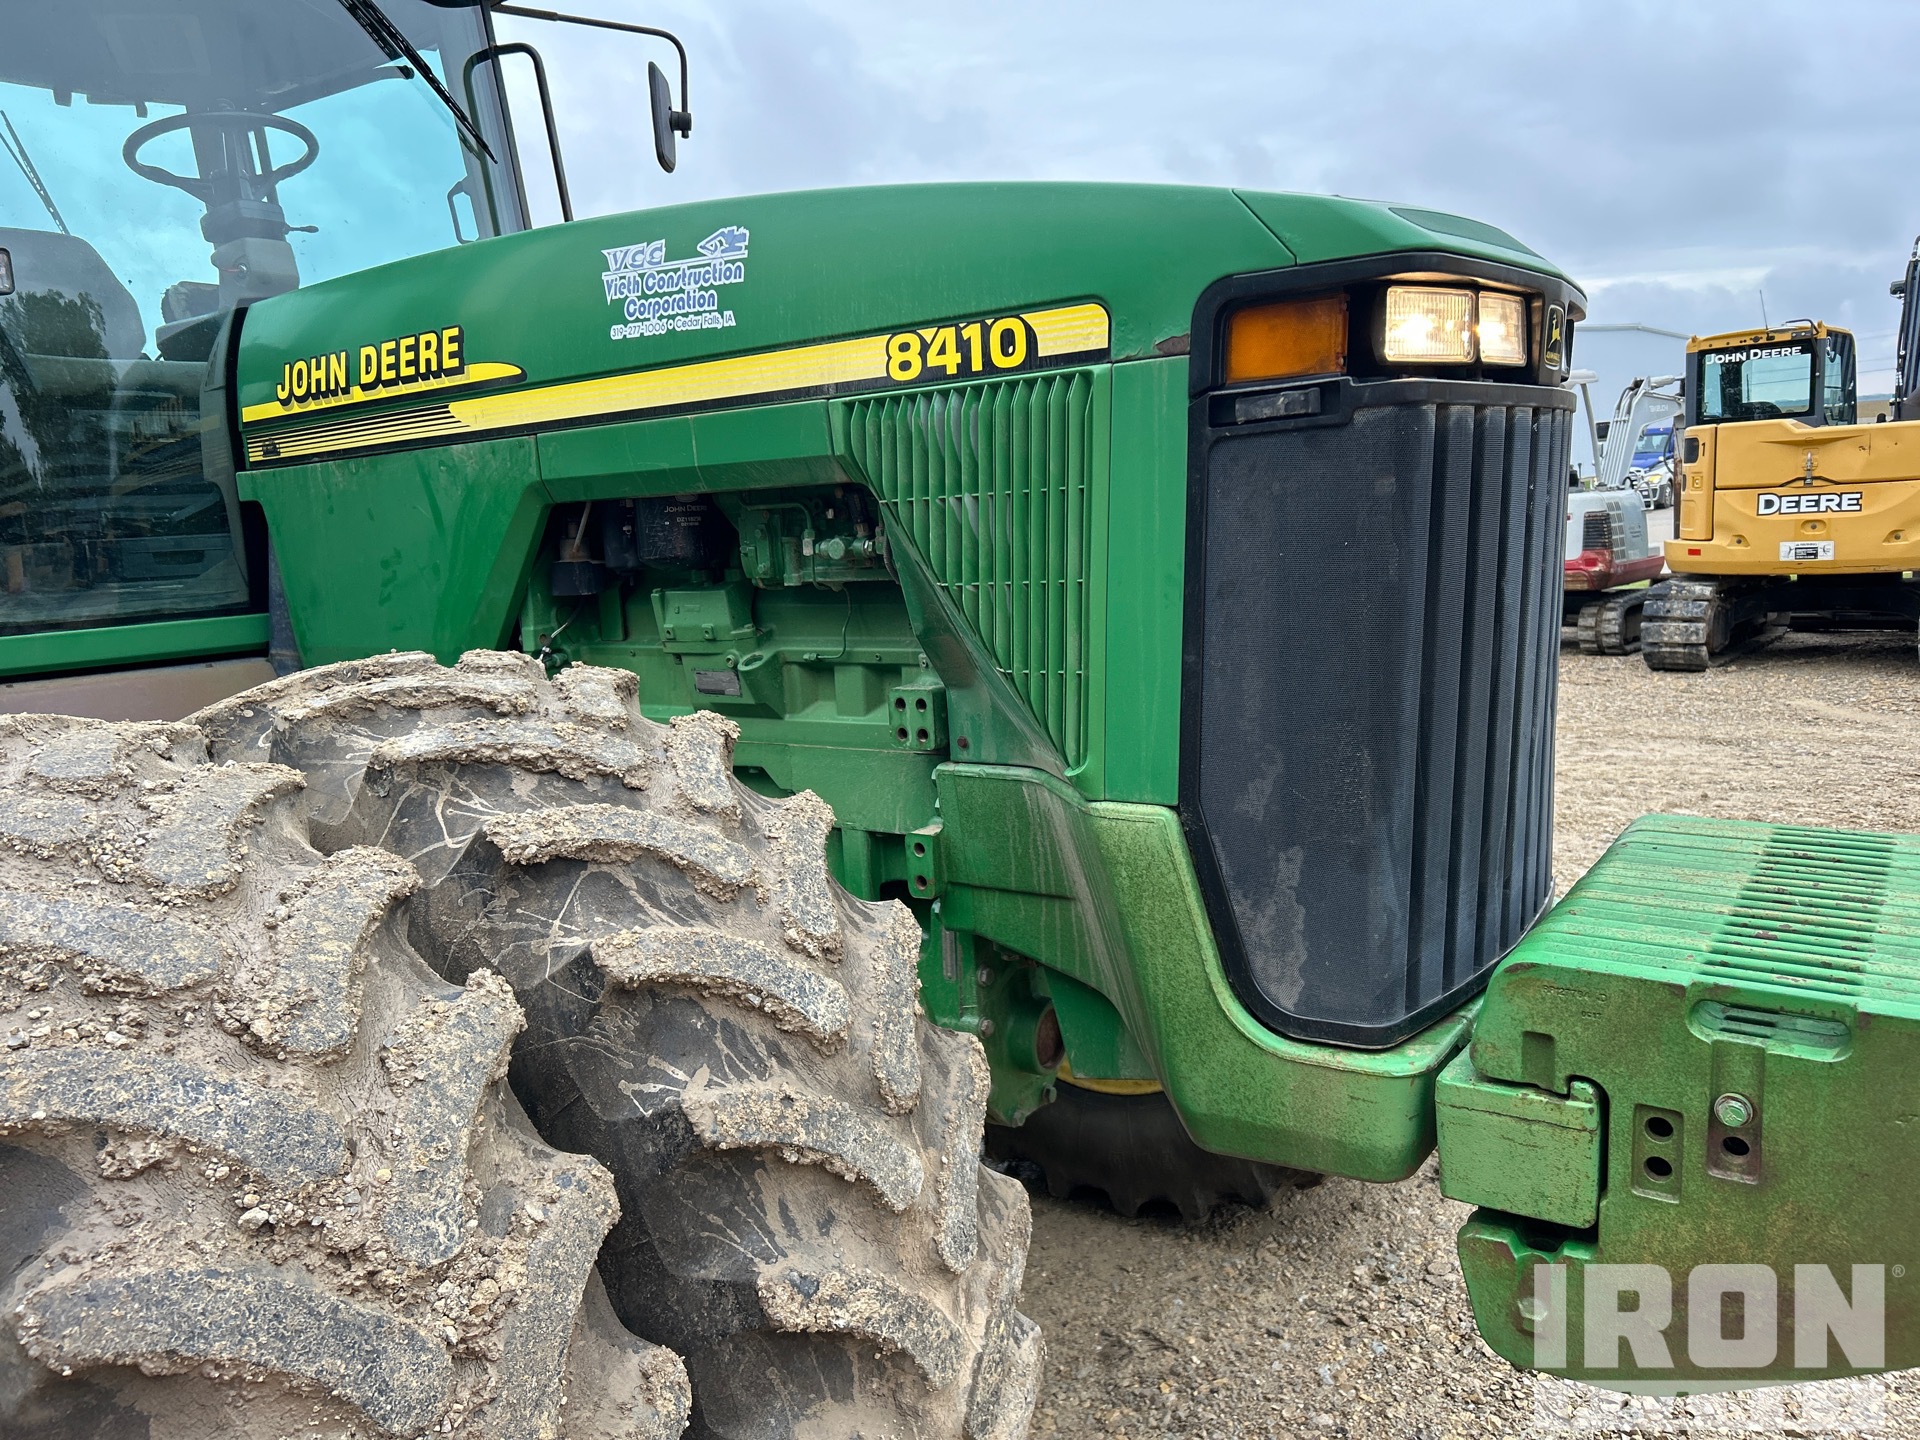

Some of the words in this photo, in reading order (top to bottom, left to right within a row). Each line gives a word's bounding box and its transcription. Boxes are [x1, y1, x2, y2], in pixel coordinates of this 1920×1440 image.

[604, 275, 641, 304] Vieth
[644, 261, 743, 293] Construction
[626, 289, 717, 319] Corporation
[612, 323, 666, 337] 319-277-1006
[675, 316, 701, 329] Cedar
[704, 313, 723, 328] Falls,
[725, 312, 735, 322] IA
[887, 316, 1028, 382] 8410
[1705, 352, 1747, 365] JOHN
[1749, 346, 1802, 360] DEERE
[276, 350, 349, 403] JOHN
[359, 325, 463, 389] DEERE
[664, 505, 686, 513] JOHN
[1757, 492, 1862, 515] DEERE
